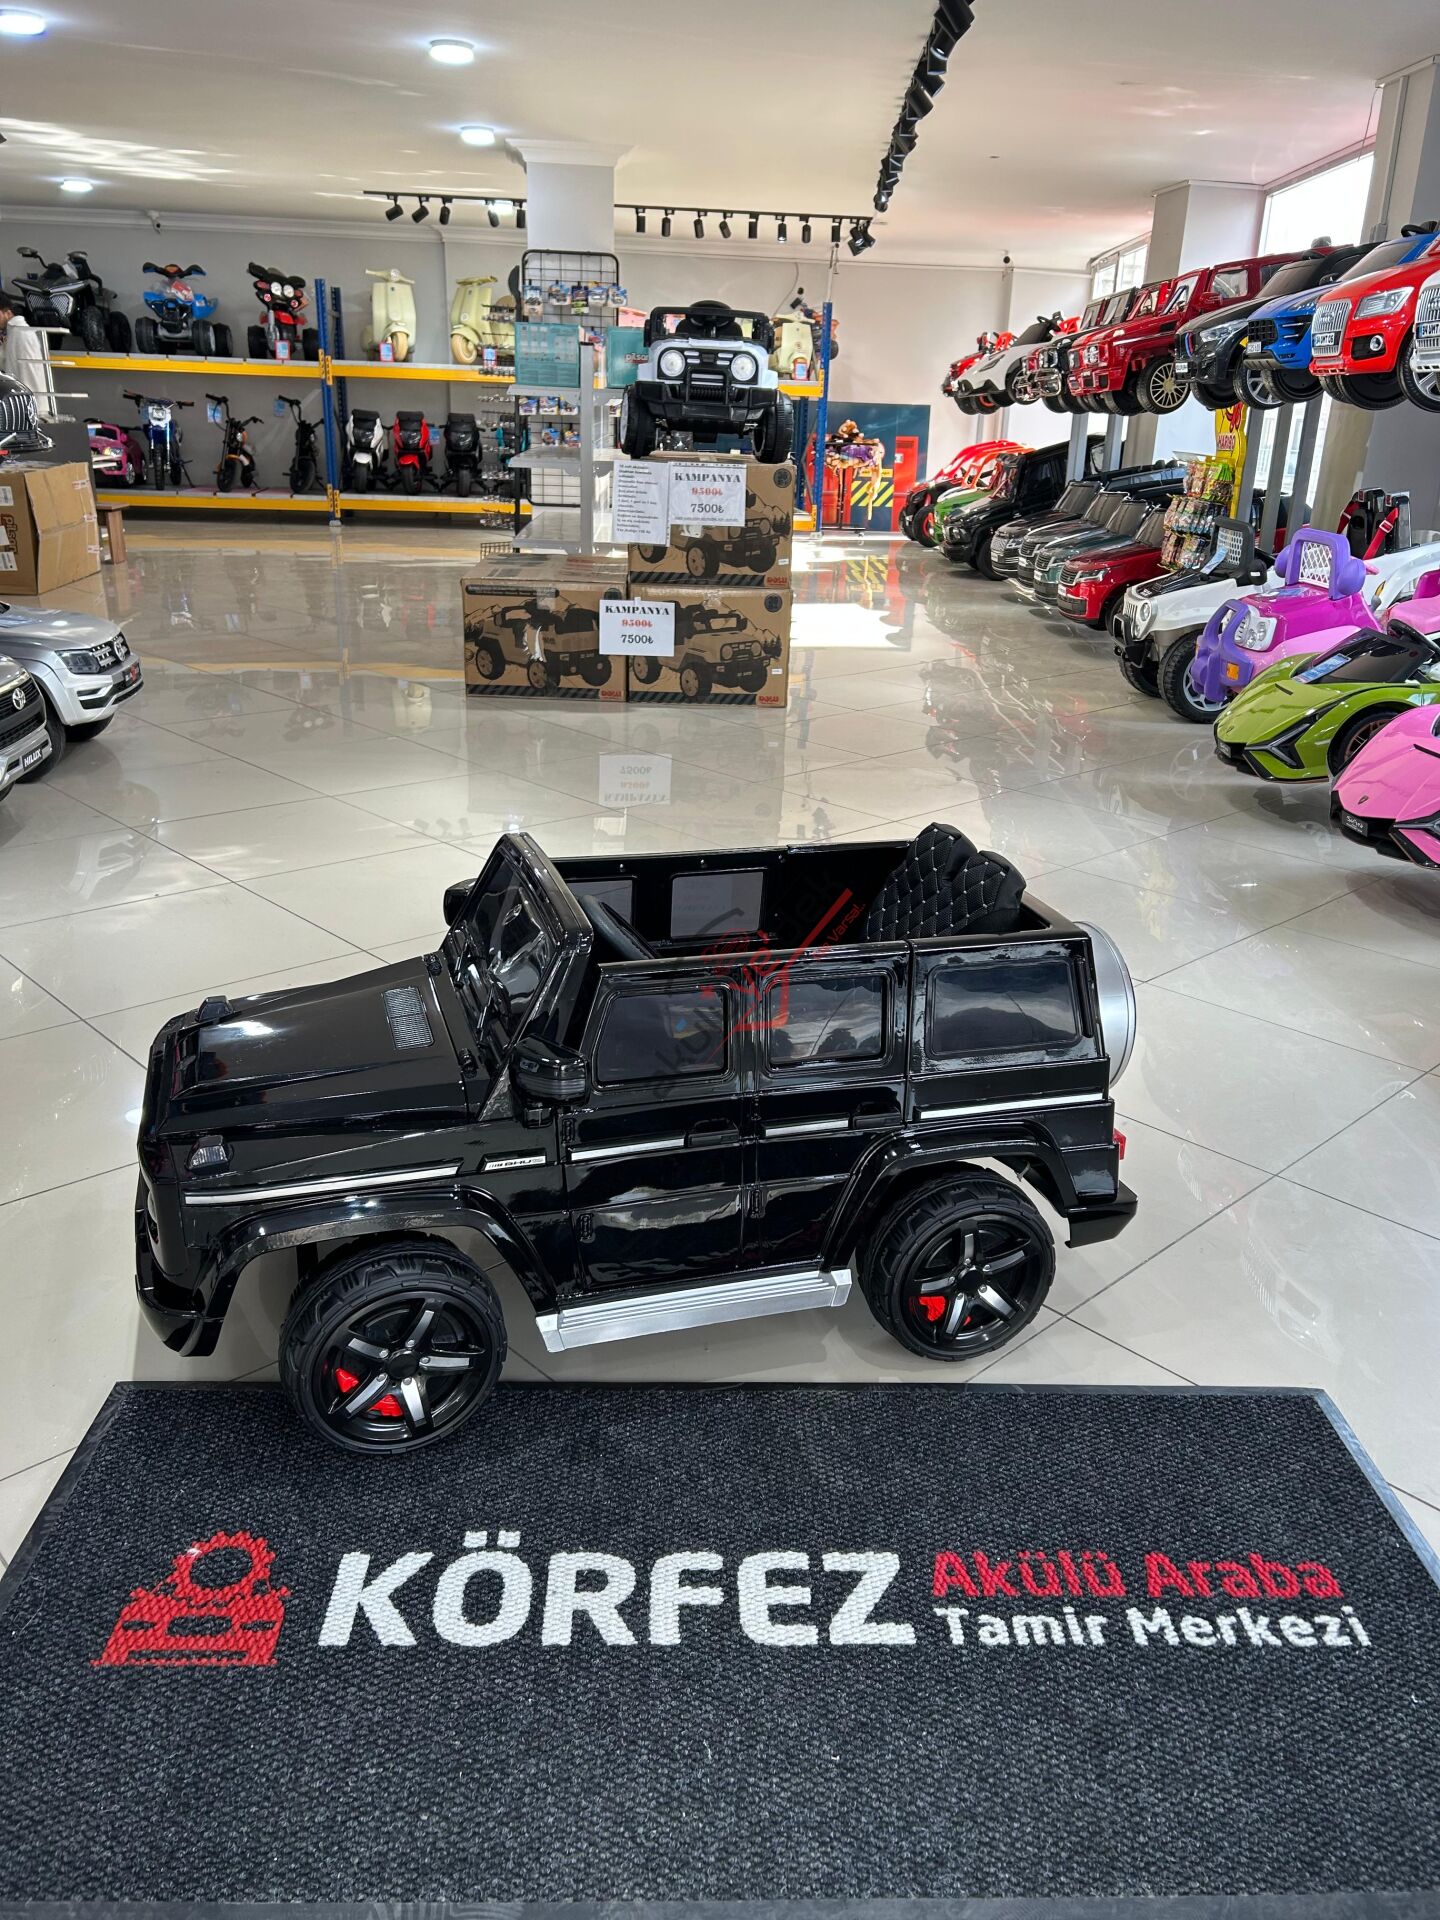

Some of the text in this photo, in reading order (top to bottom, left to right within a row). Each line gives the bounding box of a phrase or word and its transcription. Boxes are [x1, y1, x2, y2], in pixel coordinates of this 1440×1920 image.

[674, 472, 741, 484] KAMPANYA
[605, 605, 670, 616] KAMPANYA
[23, 748, 42, 766] HILUX
[319, 1530, 916, 1647] KÖRFEZ
[933, 1550, 1344, 1599] Akülü Araba
[933, 1604, 1371, 1648] Tamir Merkezi
